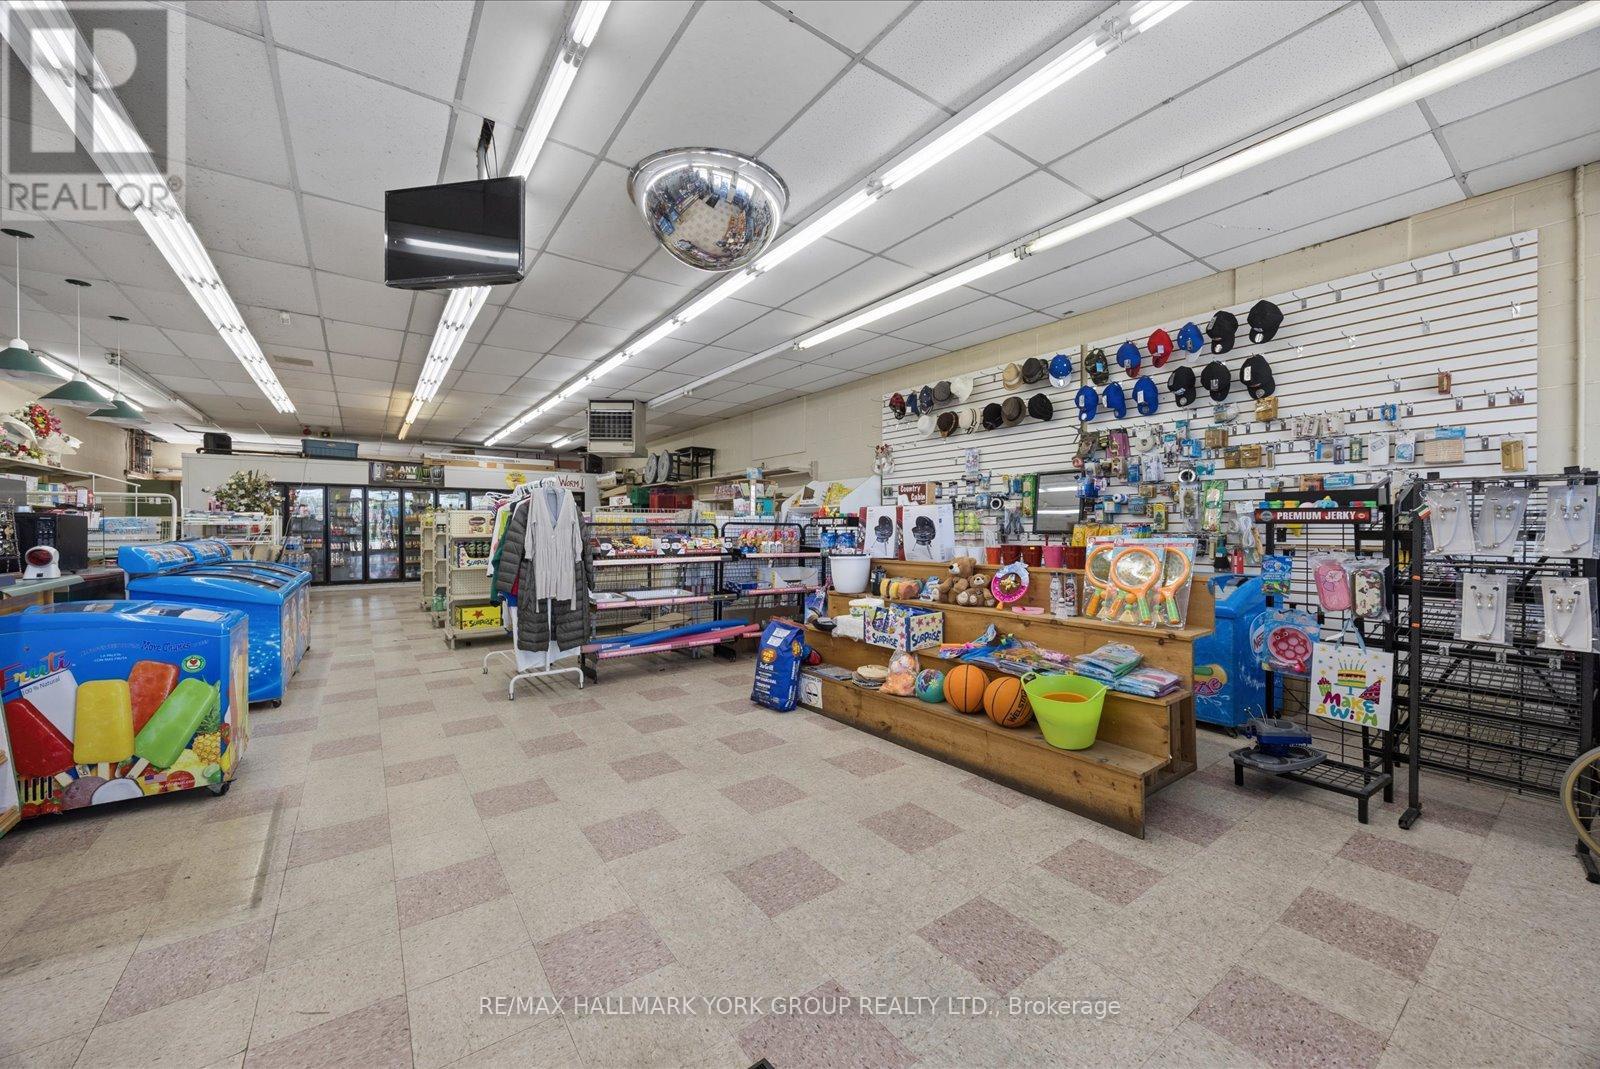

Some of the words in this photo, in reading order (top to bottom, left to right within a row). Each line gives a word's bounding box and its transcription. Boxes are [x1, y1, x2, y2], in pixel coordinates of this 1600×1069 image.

[400, 465, 417, 473] ANY
[558, 474, 580, 487] WORM
[1277, 511, 1322, 520] PREMIUM
[1325, 511, 1356, 520] JERKY
[466, 558, 489, 567] SURPRIS
[872, 632, 899, 648] SURPRISE
[911, 630, 942, 647] SURPRISE
[39, 675, 61, 689] Natural
